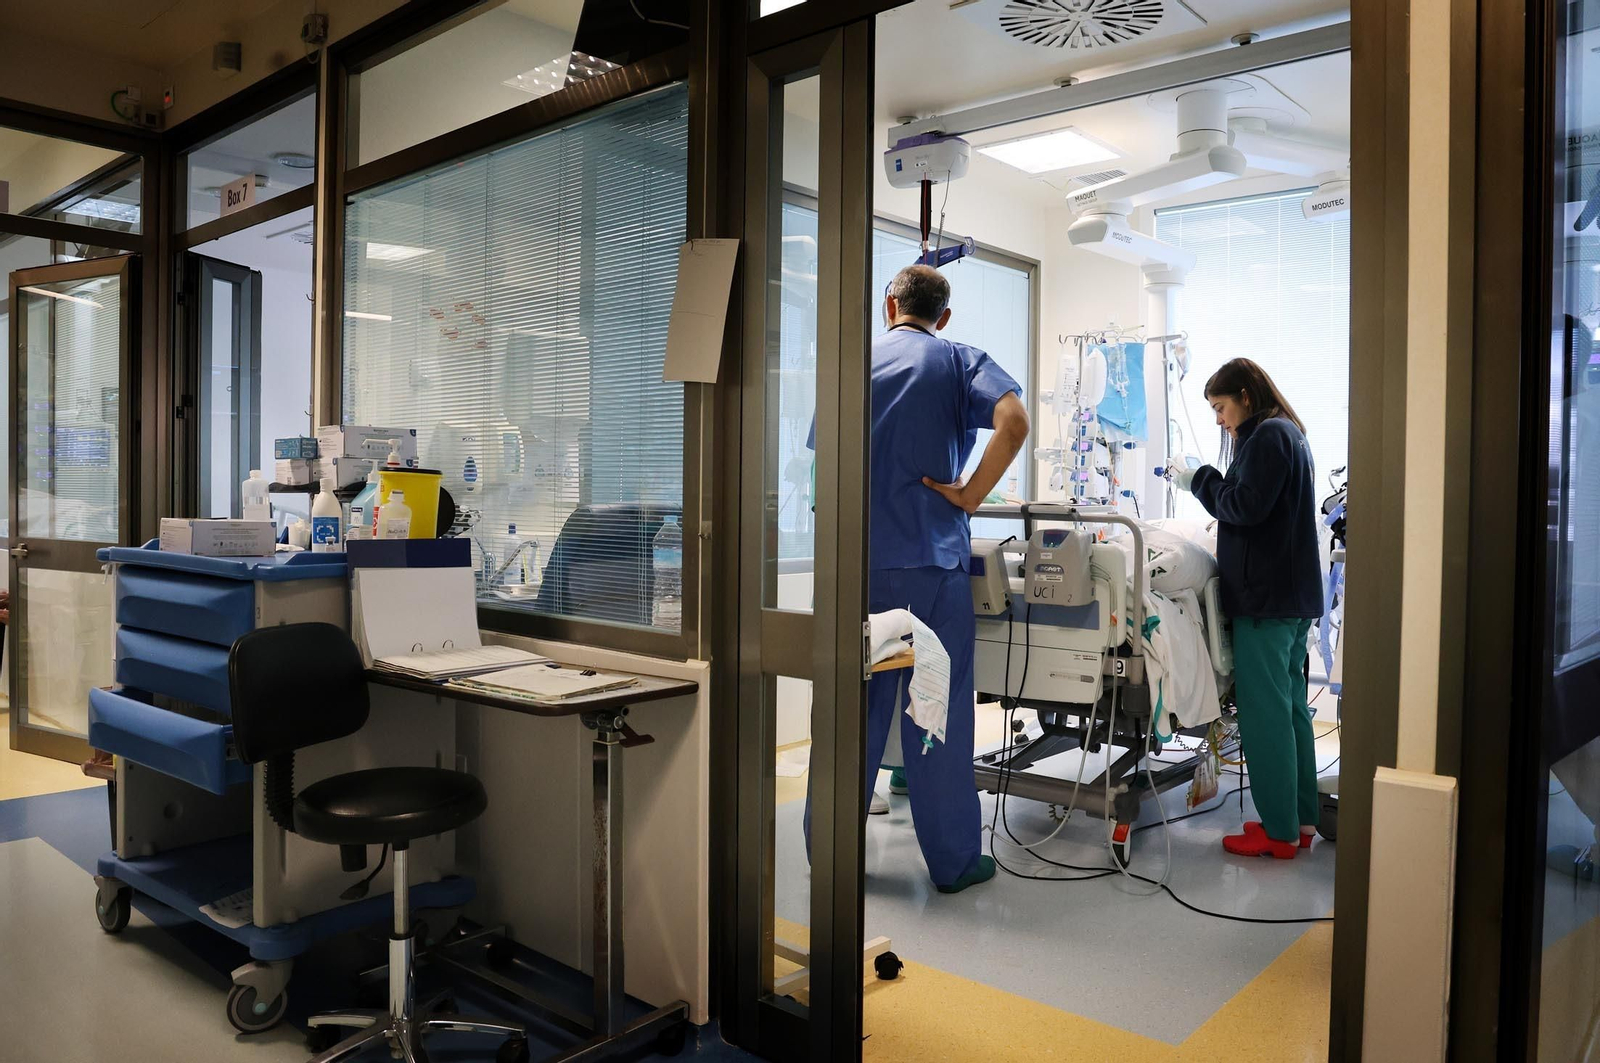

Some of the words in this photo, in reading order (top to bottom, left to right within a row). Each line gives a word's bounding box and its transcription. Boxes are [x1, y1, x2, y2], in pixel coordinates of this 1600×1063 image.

[227, 189, 241, 207] Box
[243, 183, 248, 201] 7
[1074, 190, 1097, 203] MAQUET
[1311, 198, 1345, 211] MODUTEC
[1116, 660, 1124, 675] 9
